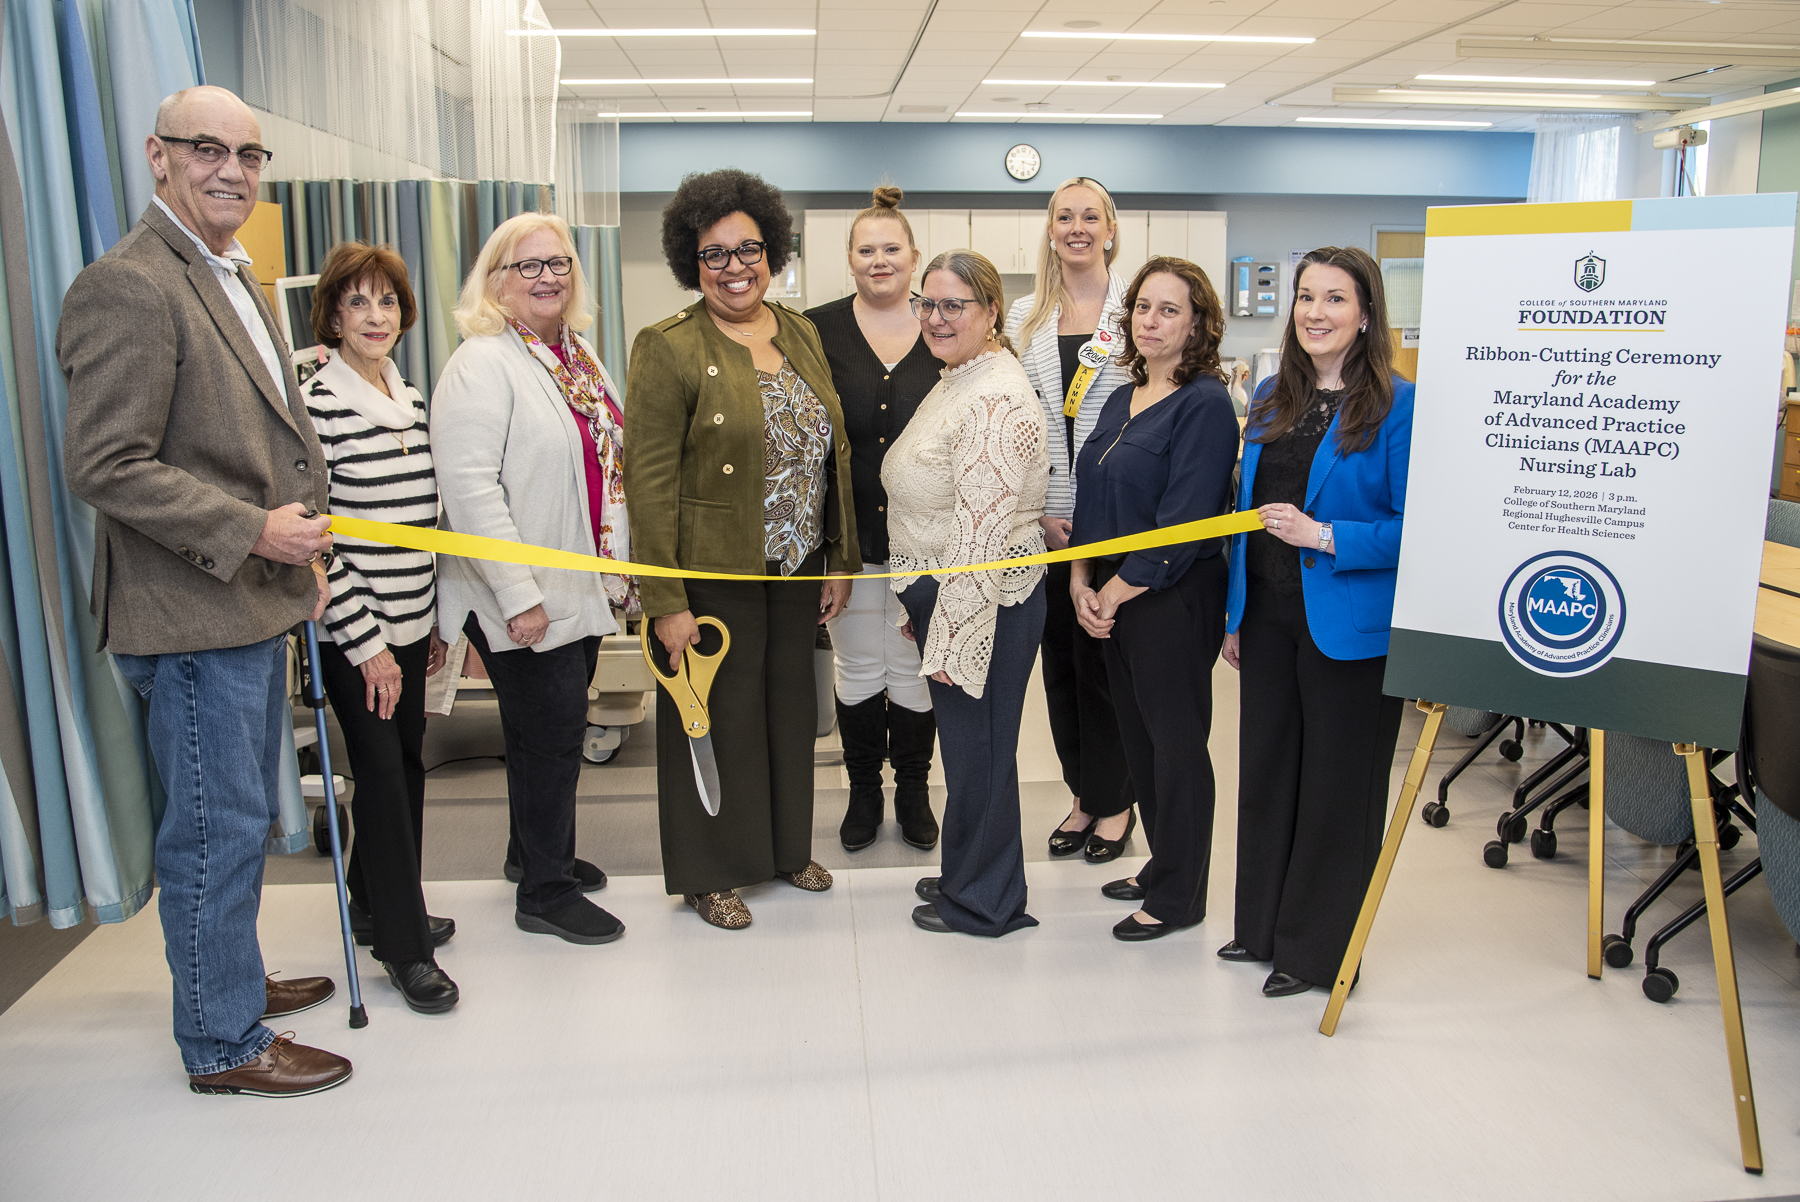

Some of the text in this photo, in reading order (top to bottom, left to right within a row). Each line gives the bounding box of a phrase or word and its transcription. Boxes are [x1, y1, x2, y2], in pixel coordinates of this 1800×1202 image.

[1518, 310, 1666, 324] FOUNDATION
[1466, 346, 1722, 368] Ribbon-Cutting Ceremony
[1551, 370, 1616, 387] for the
[1069, 369, 1087, 413] ALUMNI
[1493, 391, 1680, 414] Maryland Academy
[1485, 412, 1685, 434] of Advanced Practice
[1486, 433, 1679, 460] Clinicians (MAAPC)
[1519, 457, 1636, 478] Nursing Lab
[1514, 486, 1556, 497] February
[1559, 490, 1571, 498] 12,
[1574, 491, 1598, 499] 2026
[1504, 497, 1537, 508] College
[1551, 501, 1595, 511] Southern
[1597, 504, 1645, 515] Maryland
[1503, 509, 1644, 528] Regional Hughesville Campus
[1508, 522, 1635, 539] Center for Health Sciences
[1528, 597, 1595, 619] MAAPC
[1508, 602, 1517, 630] Maryland
[1515, 630, 1537, 653] Academy
[1544, 652, 1576, 660] Advanced
[1577, 641, 1600, 657] Practice
[1598, 614, 1614, 642] Clinicians
